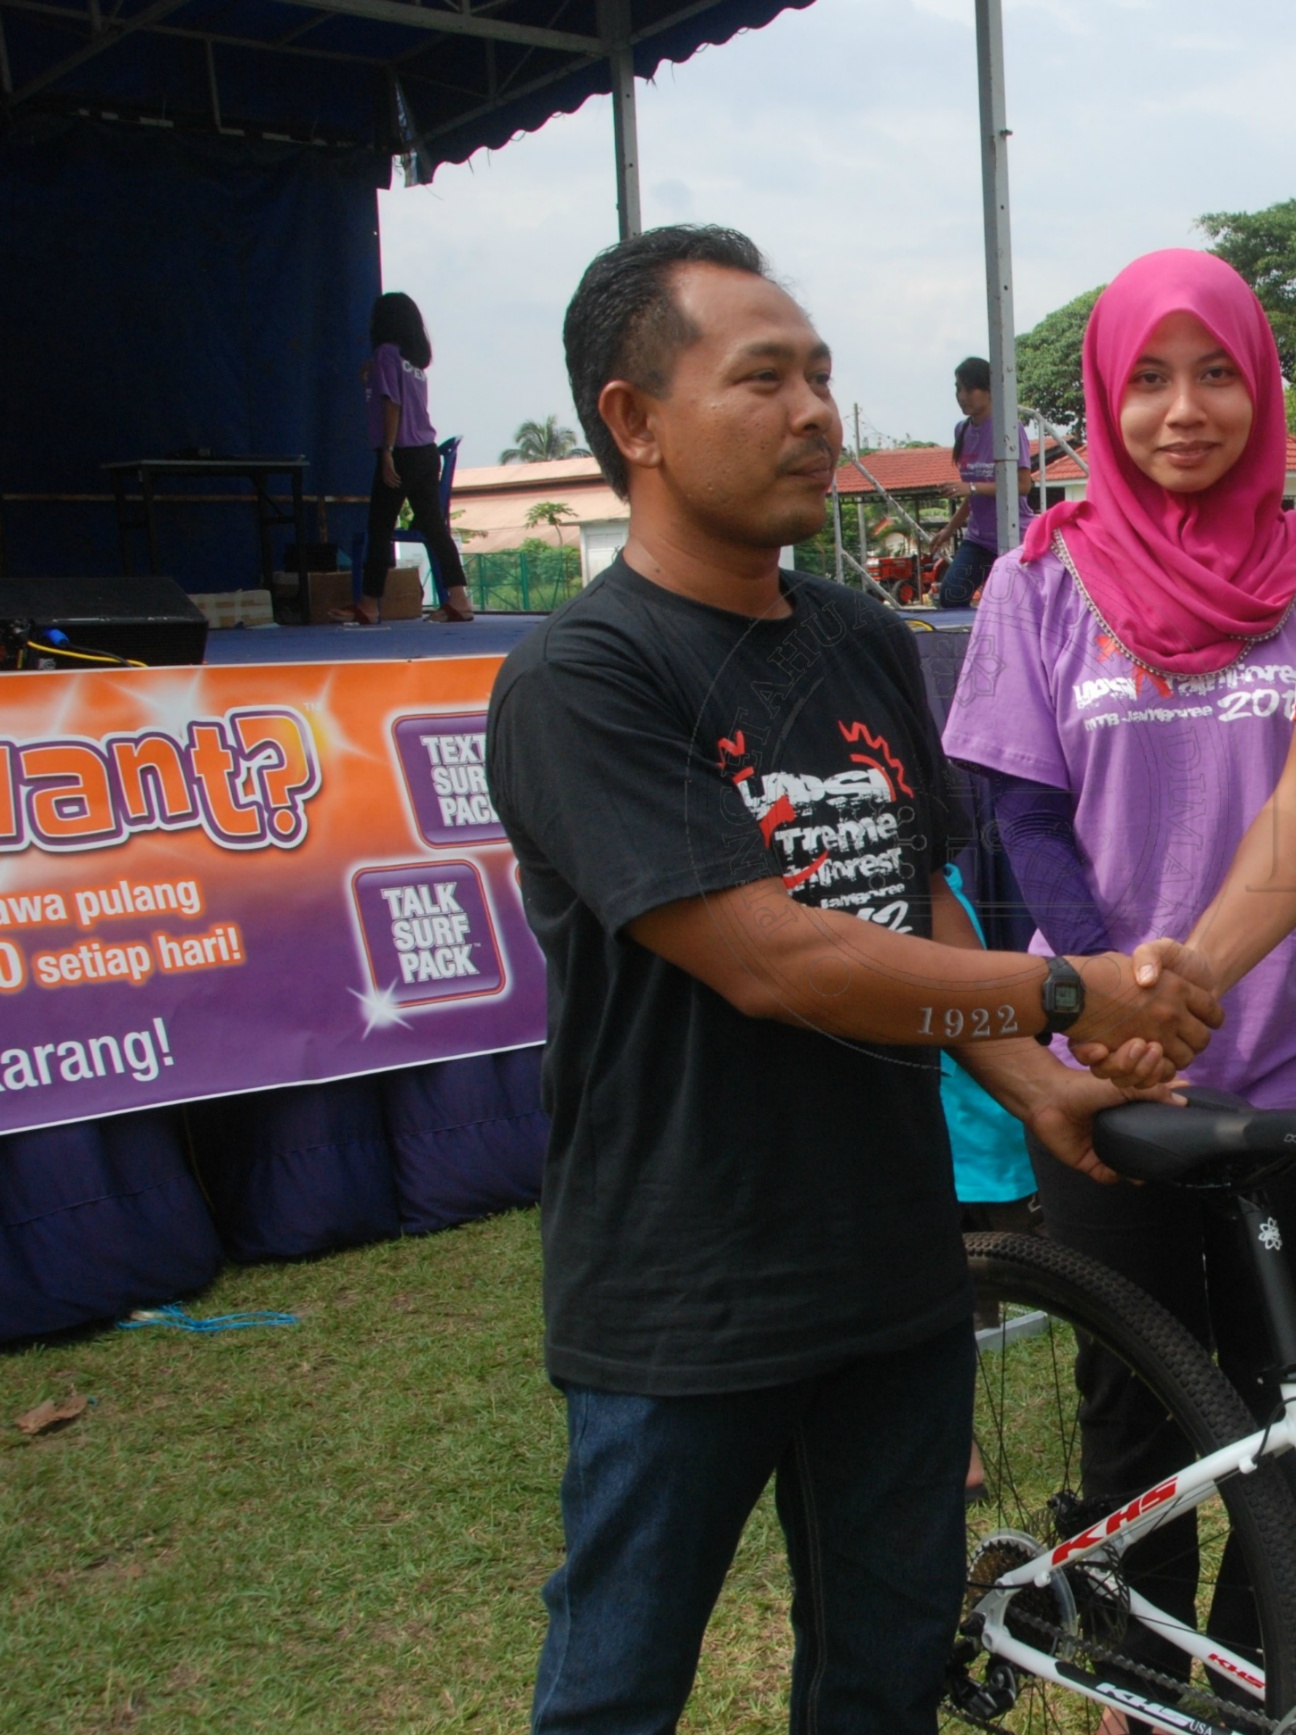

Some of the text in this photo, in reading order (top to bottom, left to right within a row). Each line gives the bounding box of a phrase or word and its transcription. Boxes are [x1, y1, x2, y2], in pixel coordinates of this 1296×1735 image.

[1217, 688, 1296, 722] 201
[431, 765, 489, 796] SUR
[75, 880, 201, 926] pulang
[381, 882, 464, 920] TALK
[391, 914, 471, 953] SURF
[37, 943, 151, 984] setiap
[158, 927, 242, 969] hari!
[398, 945, 480, 984] PACK
[0, 1016, 175, 1093] arang!
[1052, 1477, 1178, 1566] KHS
[1207, 1653, 1267, 1689] KHS
[1096, 1682, 1192, 1728] KHS
